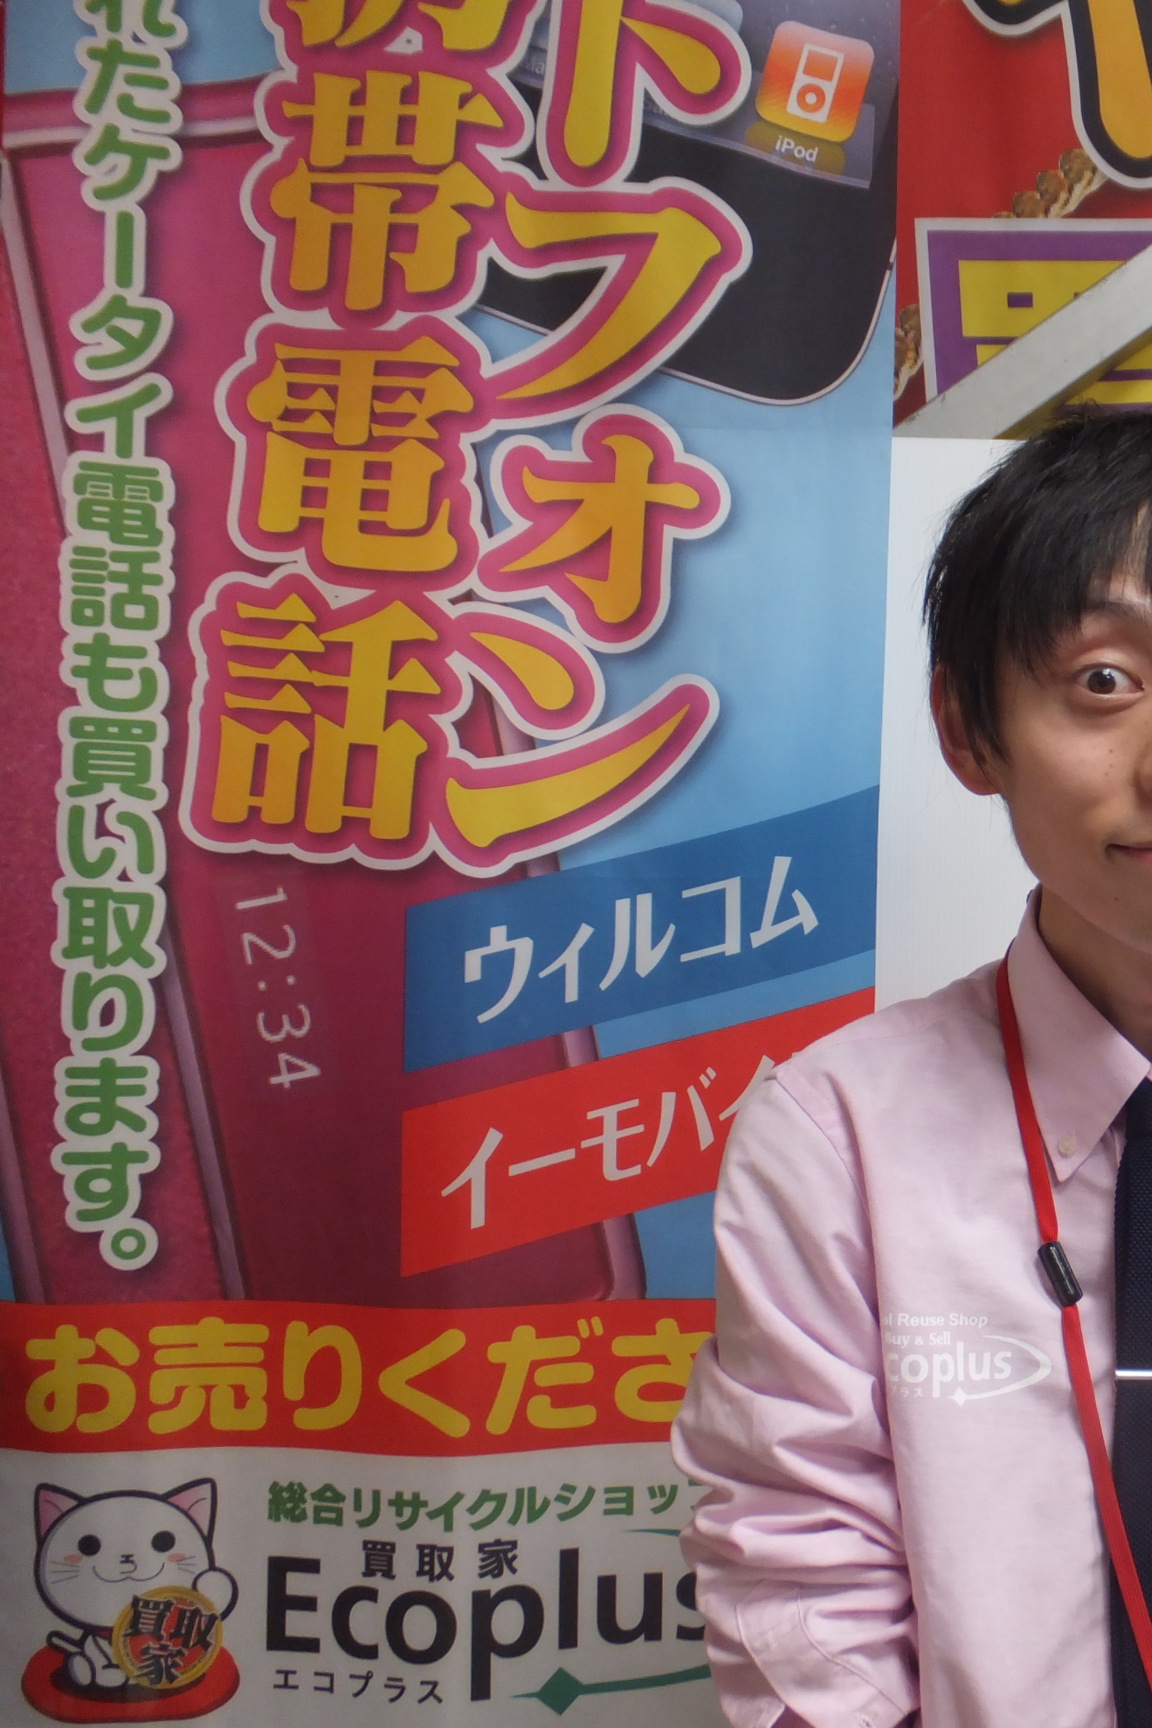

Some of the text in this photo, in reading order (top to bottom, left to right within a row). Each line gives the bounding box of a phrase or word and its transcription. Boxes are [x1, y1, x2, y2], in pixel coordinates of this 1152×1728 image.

[775, 134, 819, 163] iPod
[463, 855, 820, 1024] ウィルコム
[235, 884, 322, 1090] 12:34
[897, 1312, 945, 1327] Reuse
[949, 1312, 988, 1328] Shop
[928, 1331, 951, 1346] Sell
[266, 1480, 712, 1533] 総合リサイクルショッ
[362, 1539, 519, 1582] 買取家
[273, 1668, 444, 1705] エコプラス
